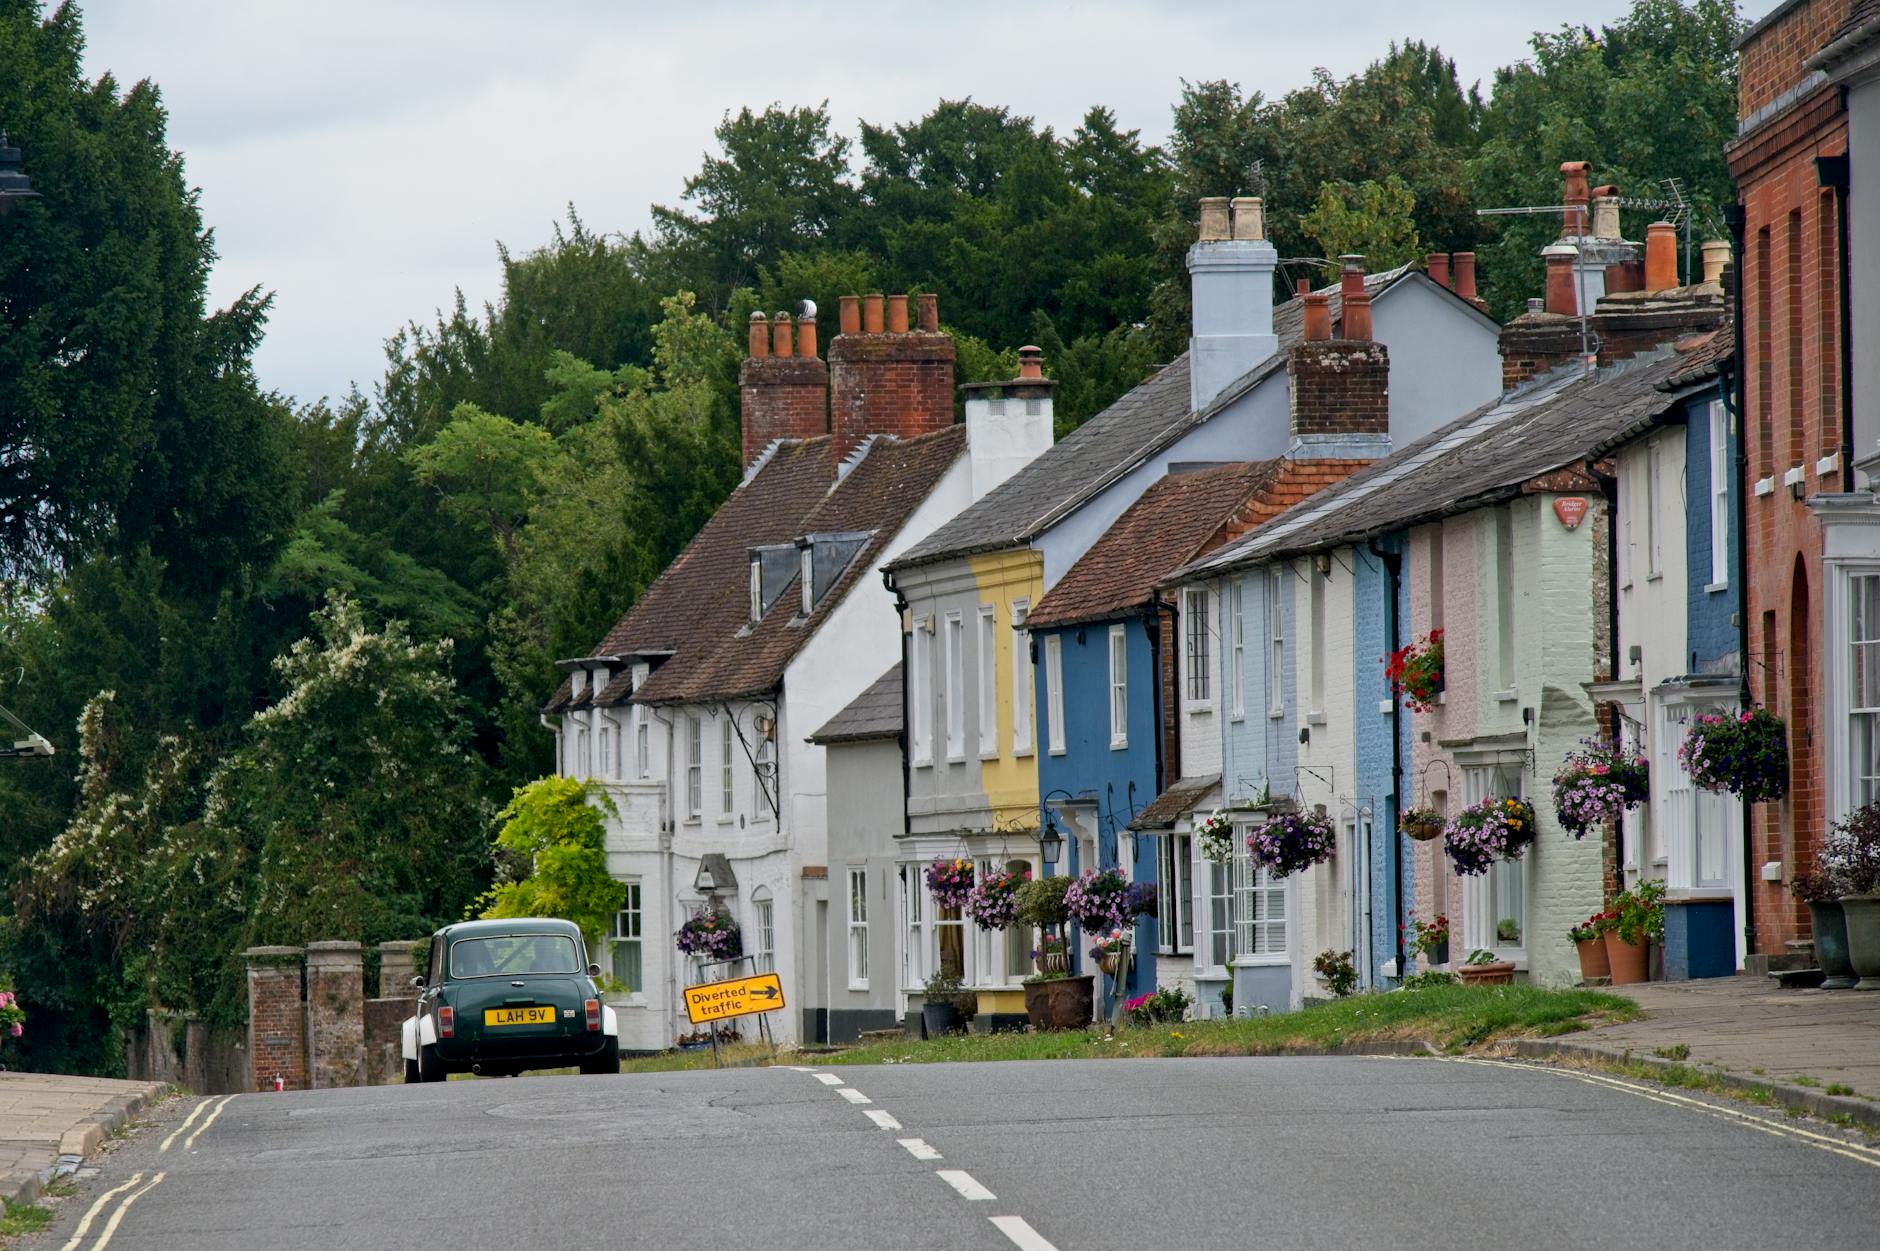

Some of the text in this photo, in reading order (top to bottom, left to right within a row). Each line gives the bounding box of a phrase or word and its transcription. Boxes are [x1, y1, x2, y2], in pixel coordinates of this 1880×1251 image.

[692, 987, 746, 1004] Diverted
[701, 1000, 742, 1015] traffic
[497, 1009, 545, 1023] LAH 9V
